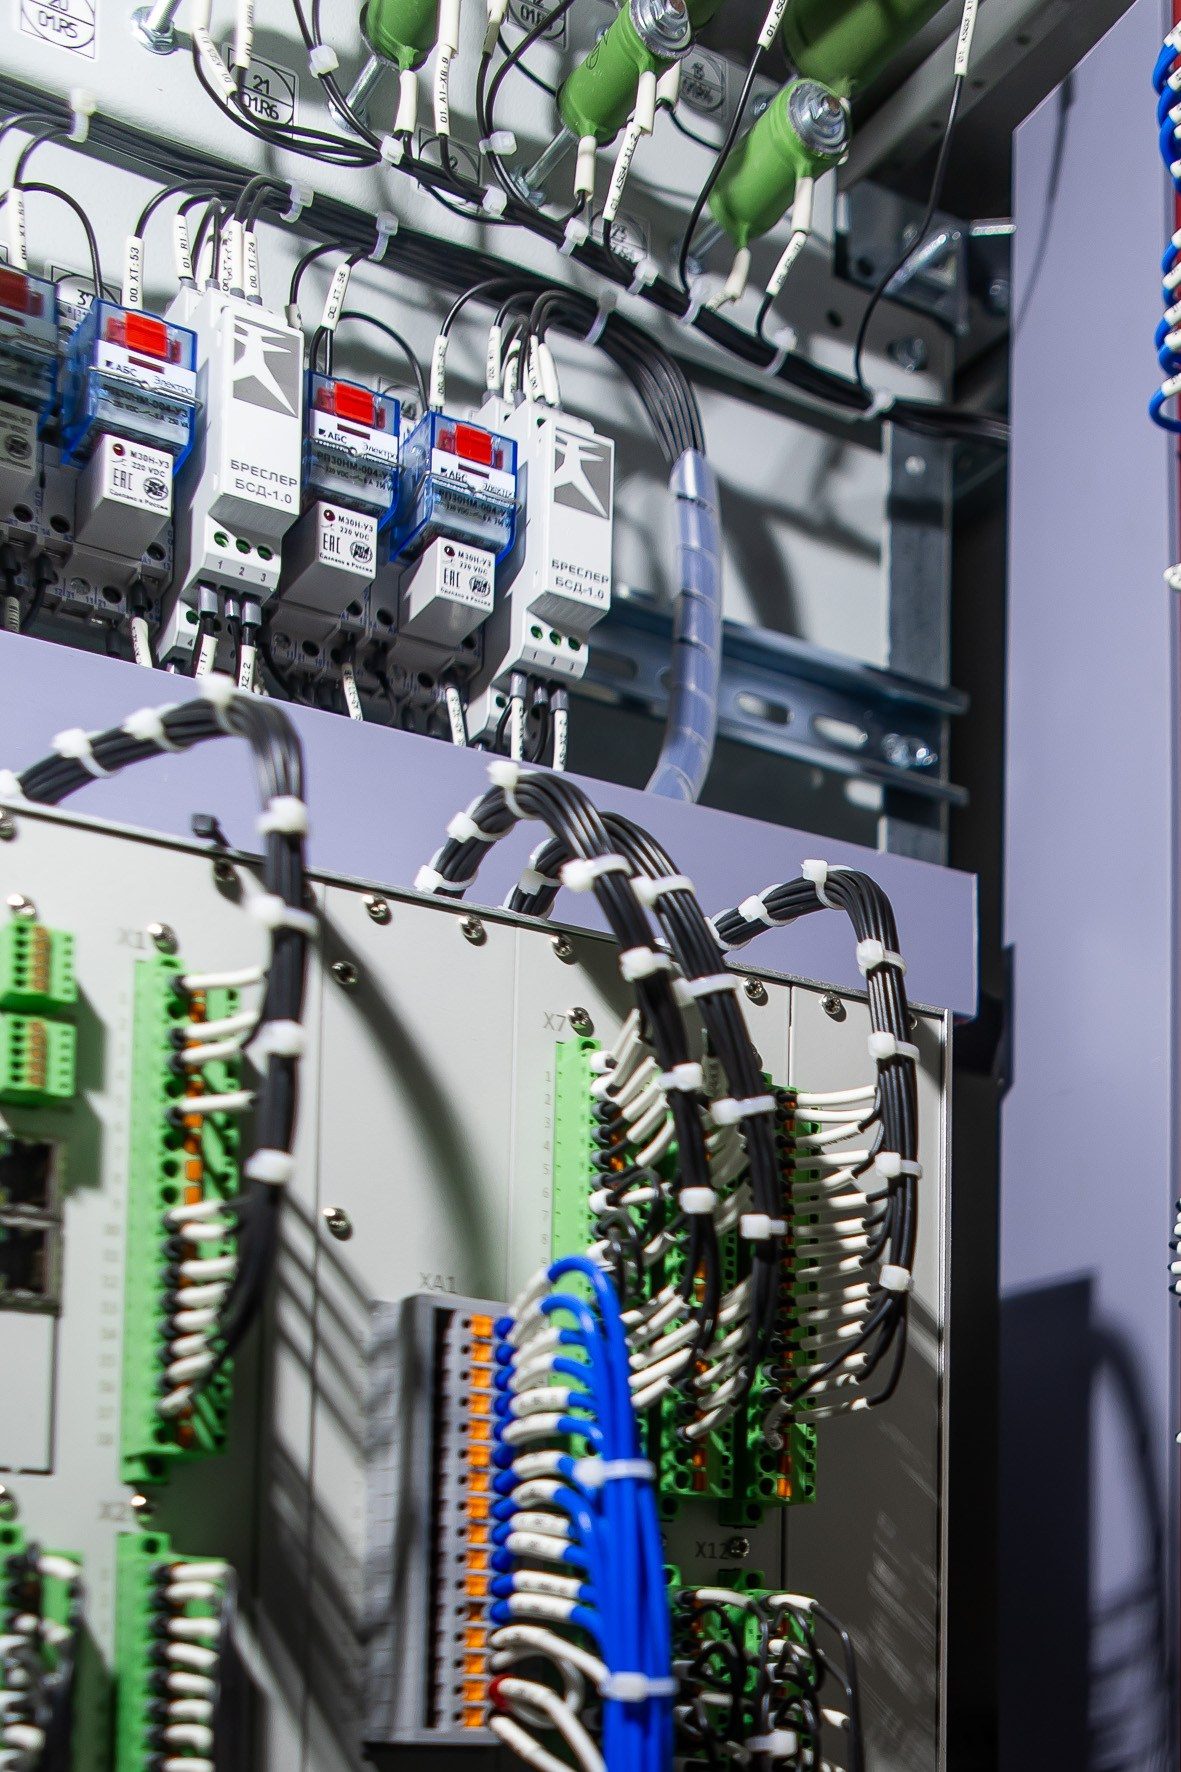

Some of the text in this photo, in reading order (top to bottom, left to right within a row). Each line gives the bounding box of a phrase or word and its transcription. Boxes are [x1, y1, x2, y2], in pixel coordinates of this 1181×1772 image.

[148, 467, 166, 478] VDC
[230, 460, 298, 487] БРЕСЛЕР
[235, 478, 292, 504] БСД-1.0
[218, 560, 266, 582] 1 2 3
[552, 559, 609, 583] БРЕСЛЕР
[555, 576, 604, 600] БСД-1.0
[188, 638, 193, 647] 4
[551, 656, 556, 665] 2
[570, 662, 574, 672] 3
